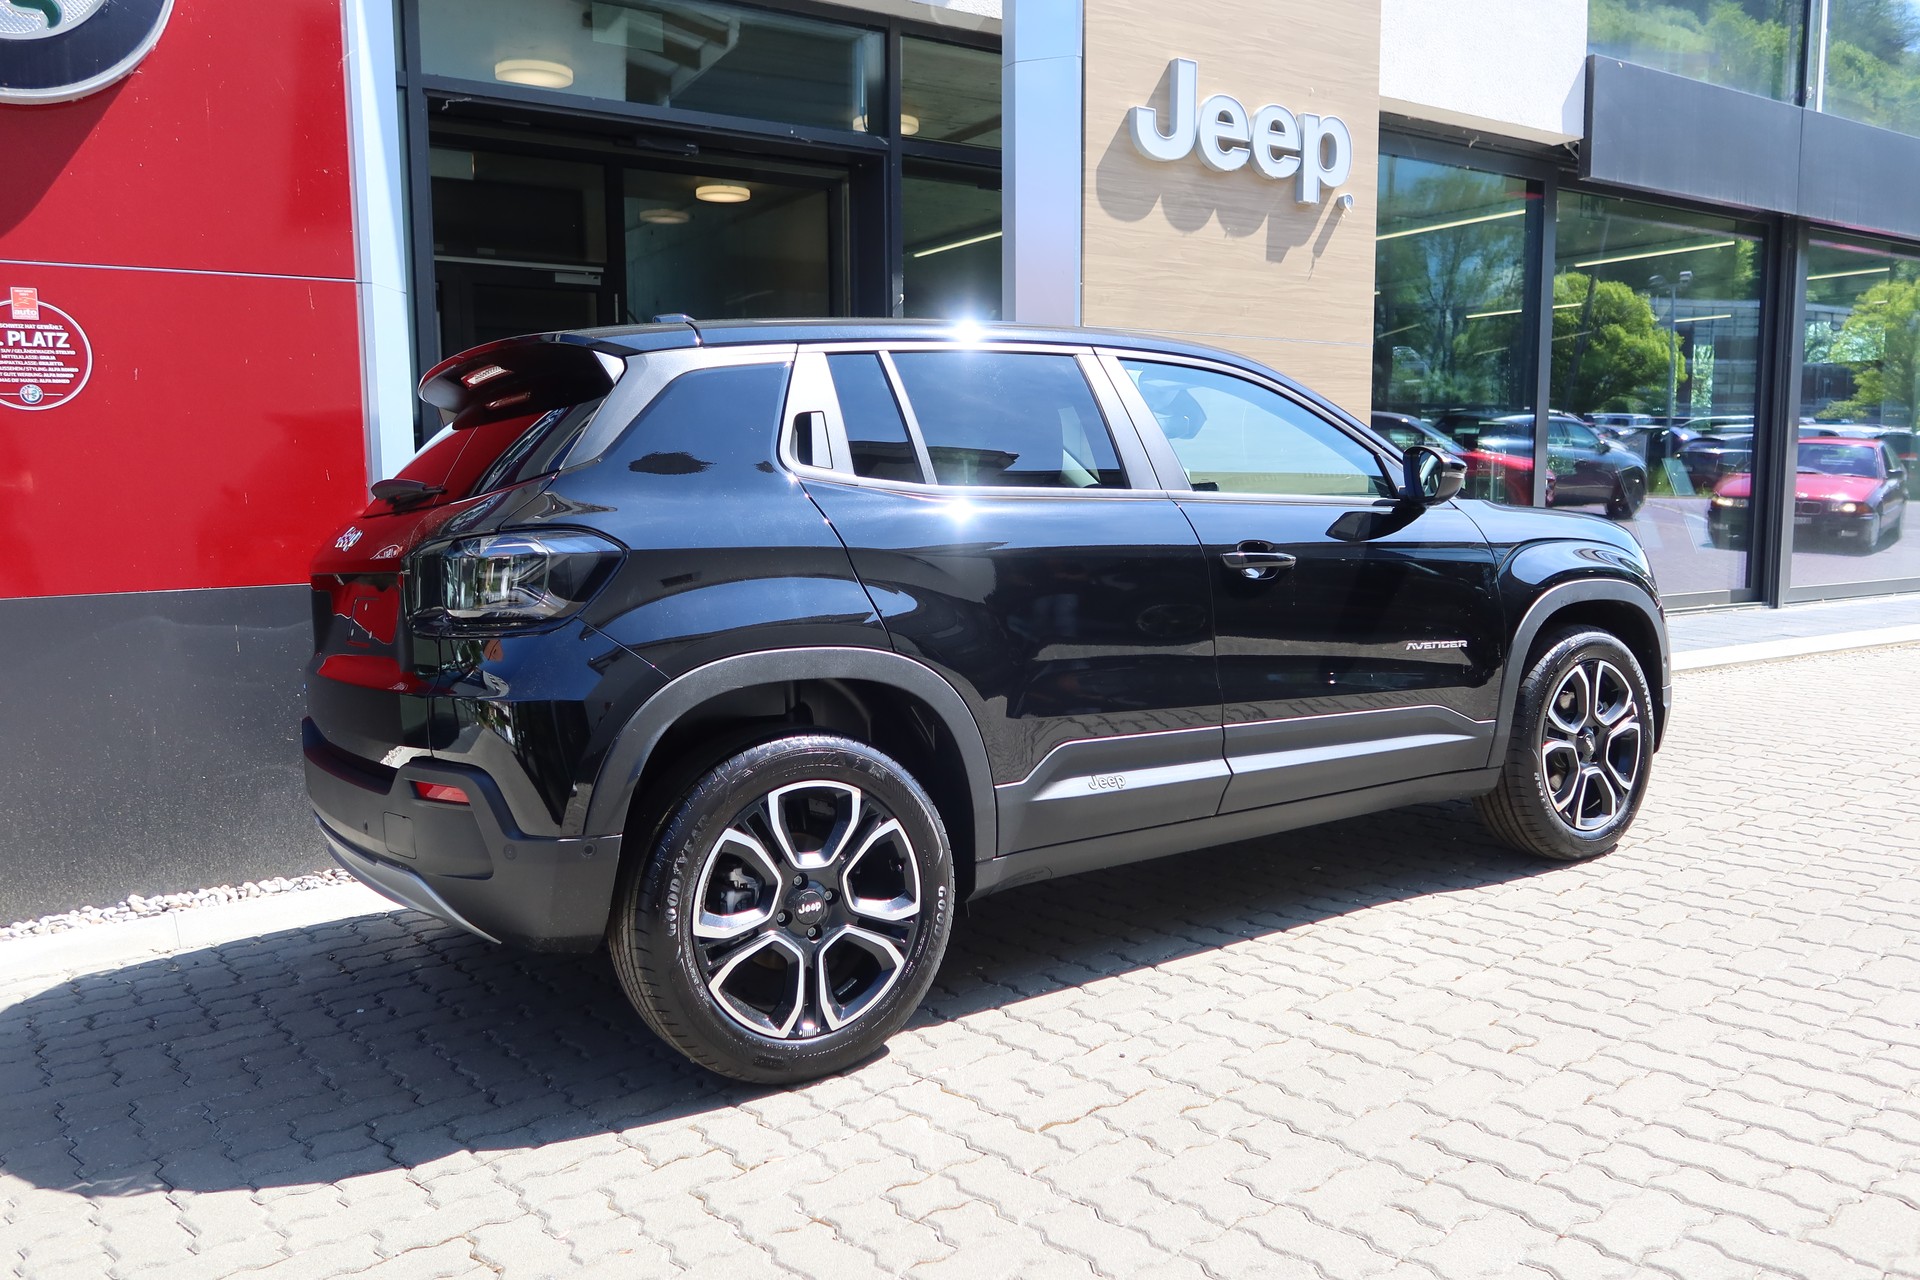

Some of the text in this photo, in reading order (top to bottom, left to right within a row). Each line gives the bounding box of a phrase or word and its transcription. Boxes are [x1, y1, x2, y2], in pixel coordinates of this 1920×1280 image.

[1129, 57, 1353, 204] Jeep
[7, 330, 70, 348] PLATZ
[1406, 640, 1468, 651] AVENGER
[1088, 774, 1126, 790] Jeep
[798, 901, 821, 914] Jeep
